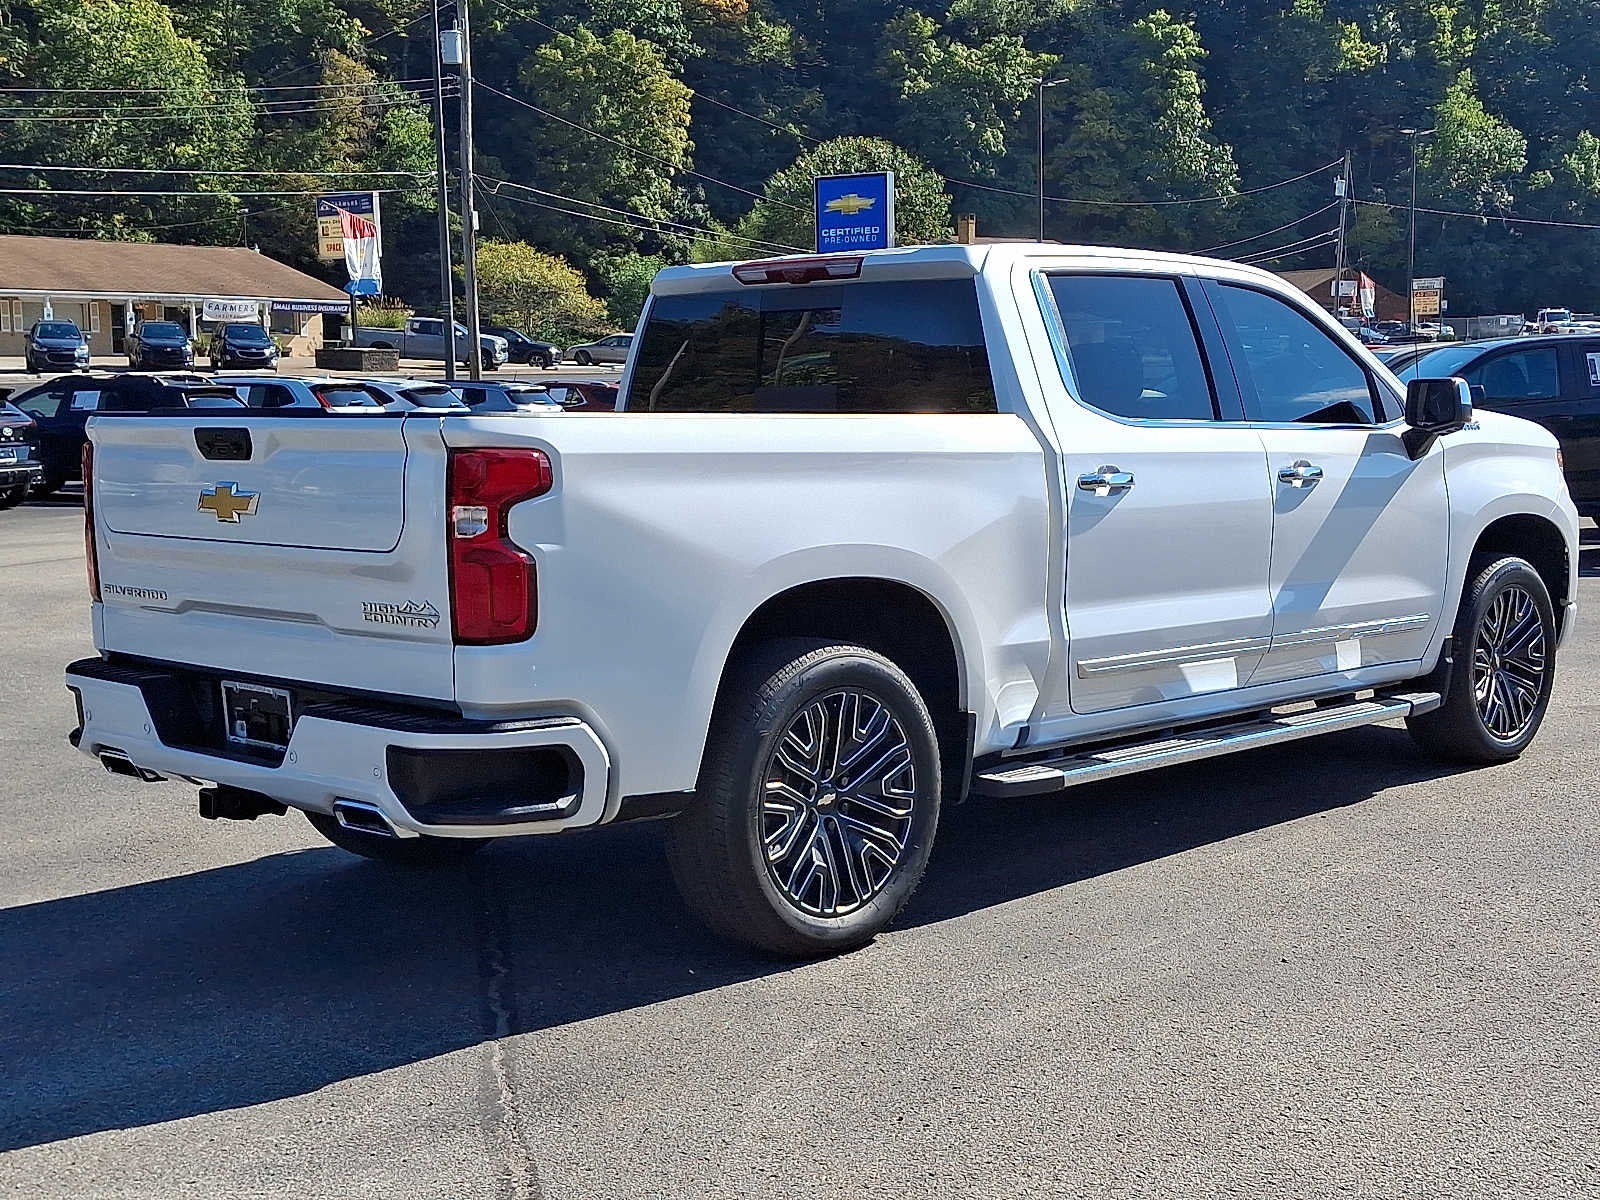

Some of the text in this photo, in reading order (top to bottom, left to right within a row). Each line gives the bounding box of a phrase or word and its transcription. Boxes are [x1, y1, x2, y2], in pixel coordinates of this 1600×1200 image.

[822, 227, 879, 236] CERTIFIED
[824, 234, 877, 244] PRE-OWNED
[326, 243, 342, 252] SPACE
[208, 302, 255, 312] FARMERS
[273, 302, 349, 312] SMALL BUSINESS INSURANCE
[103, 583, 169, 601] SILVERADO
[361, 601, 401, 614] HIGH
[363, 612, 440, 629] COUNTRY
